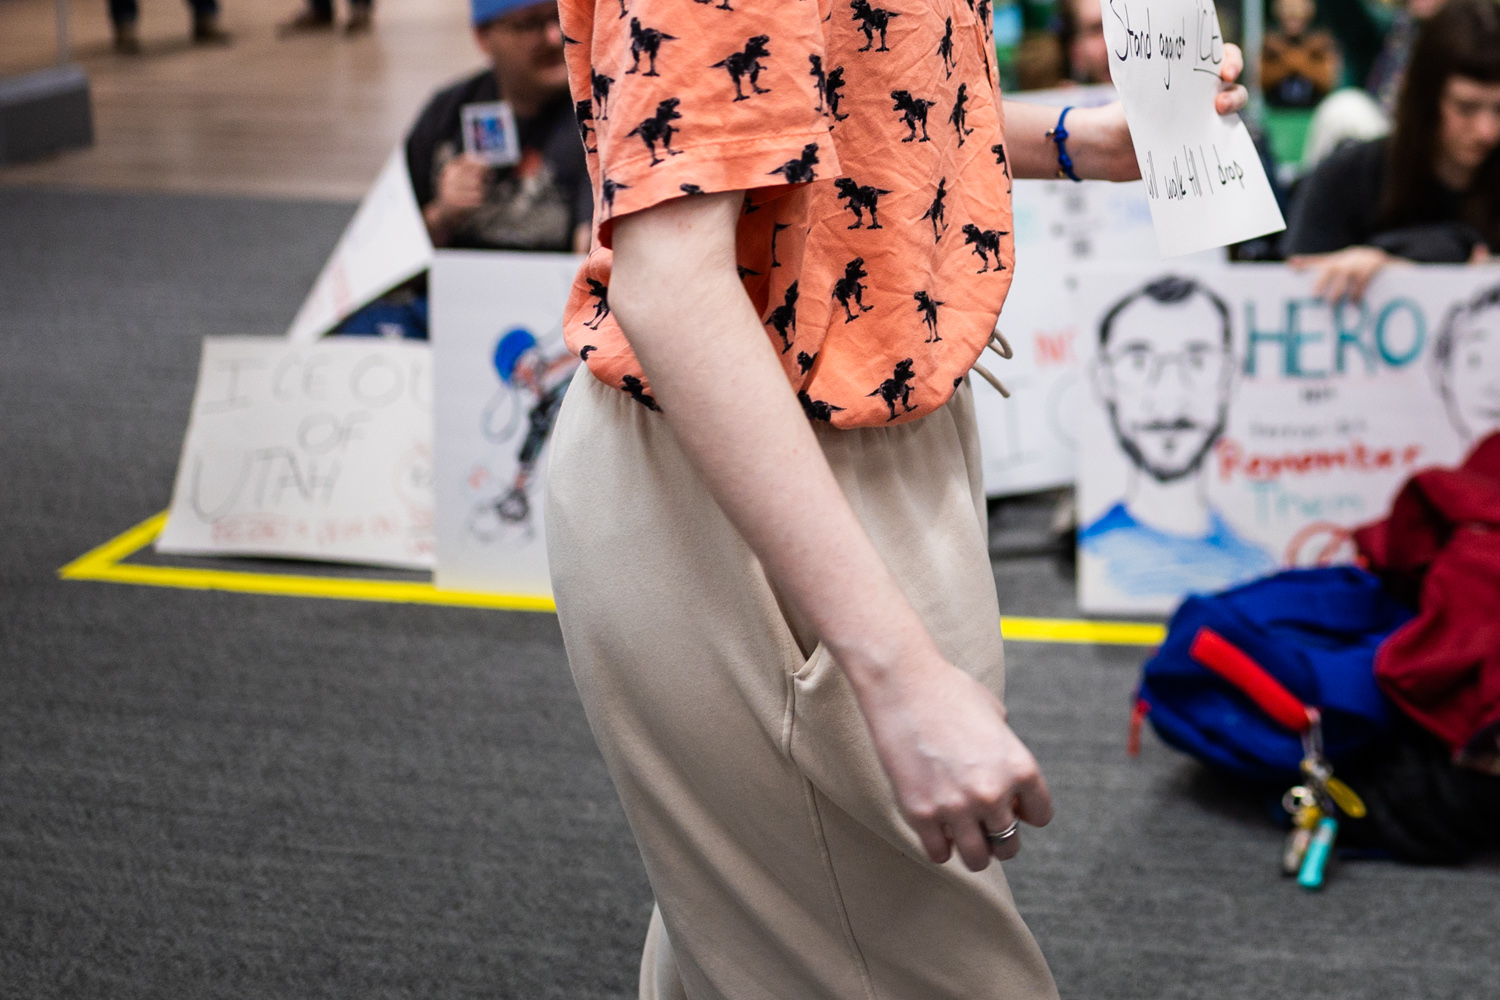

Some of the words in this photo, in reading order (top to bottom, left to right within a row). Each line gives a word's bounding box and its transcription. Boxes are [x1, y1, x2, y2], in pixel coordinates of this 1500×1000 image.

[1159, 16, 1186, 90] against
[1195, 8, 1223, 66] ICE
[1163, 155, 1187, 201] walk
[1182, 144, 1203, 198] till
[1198, 144, 1214, 196] I
[1211, 143, 1246, 190] drop
[1243, 293, 1427, 377] HERO
[200, 350, 334, 414] ICE
[296, 408, 372, 455] OF
[189, 446, 344, 524] UTAH
